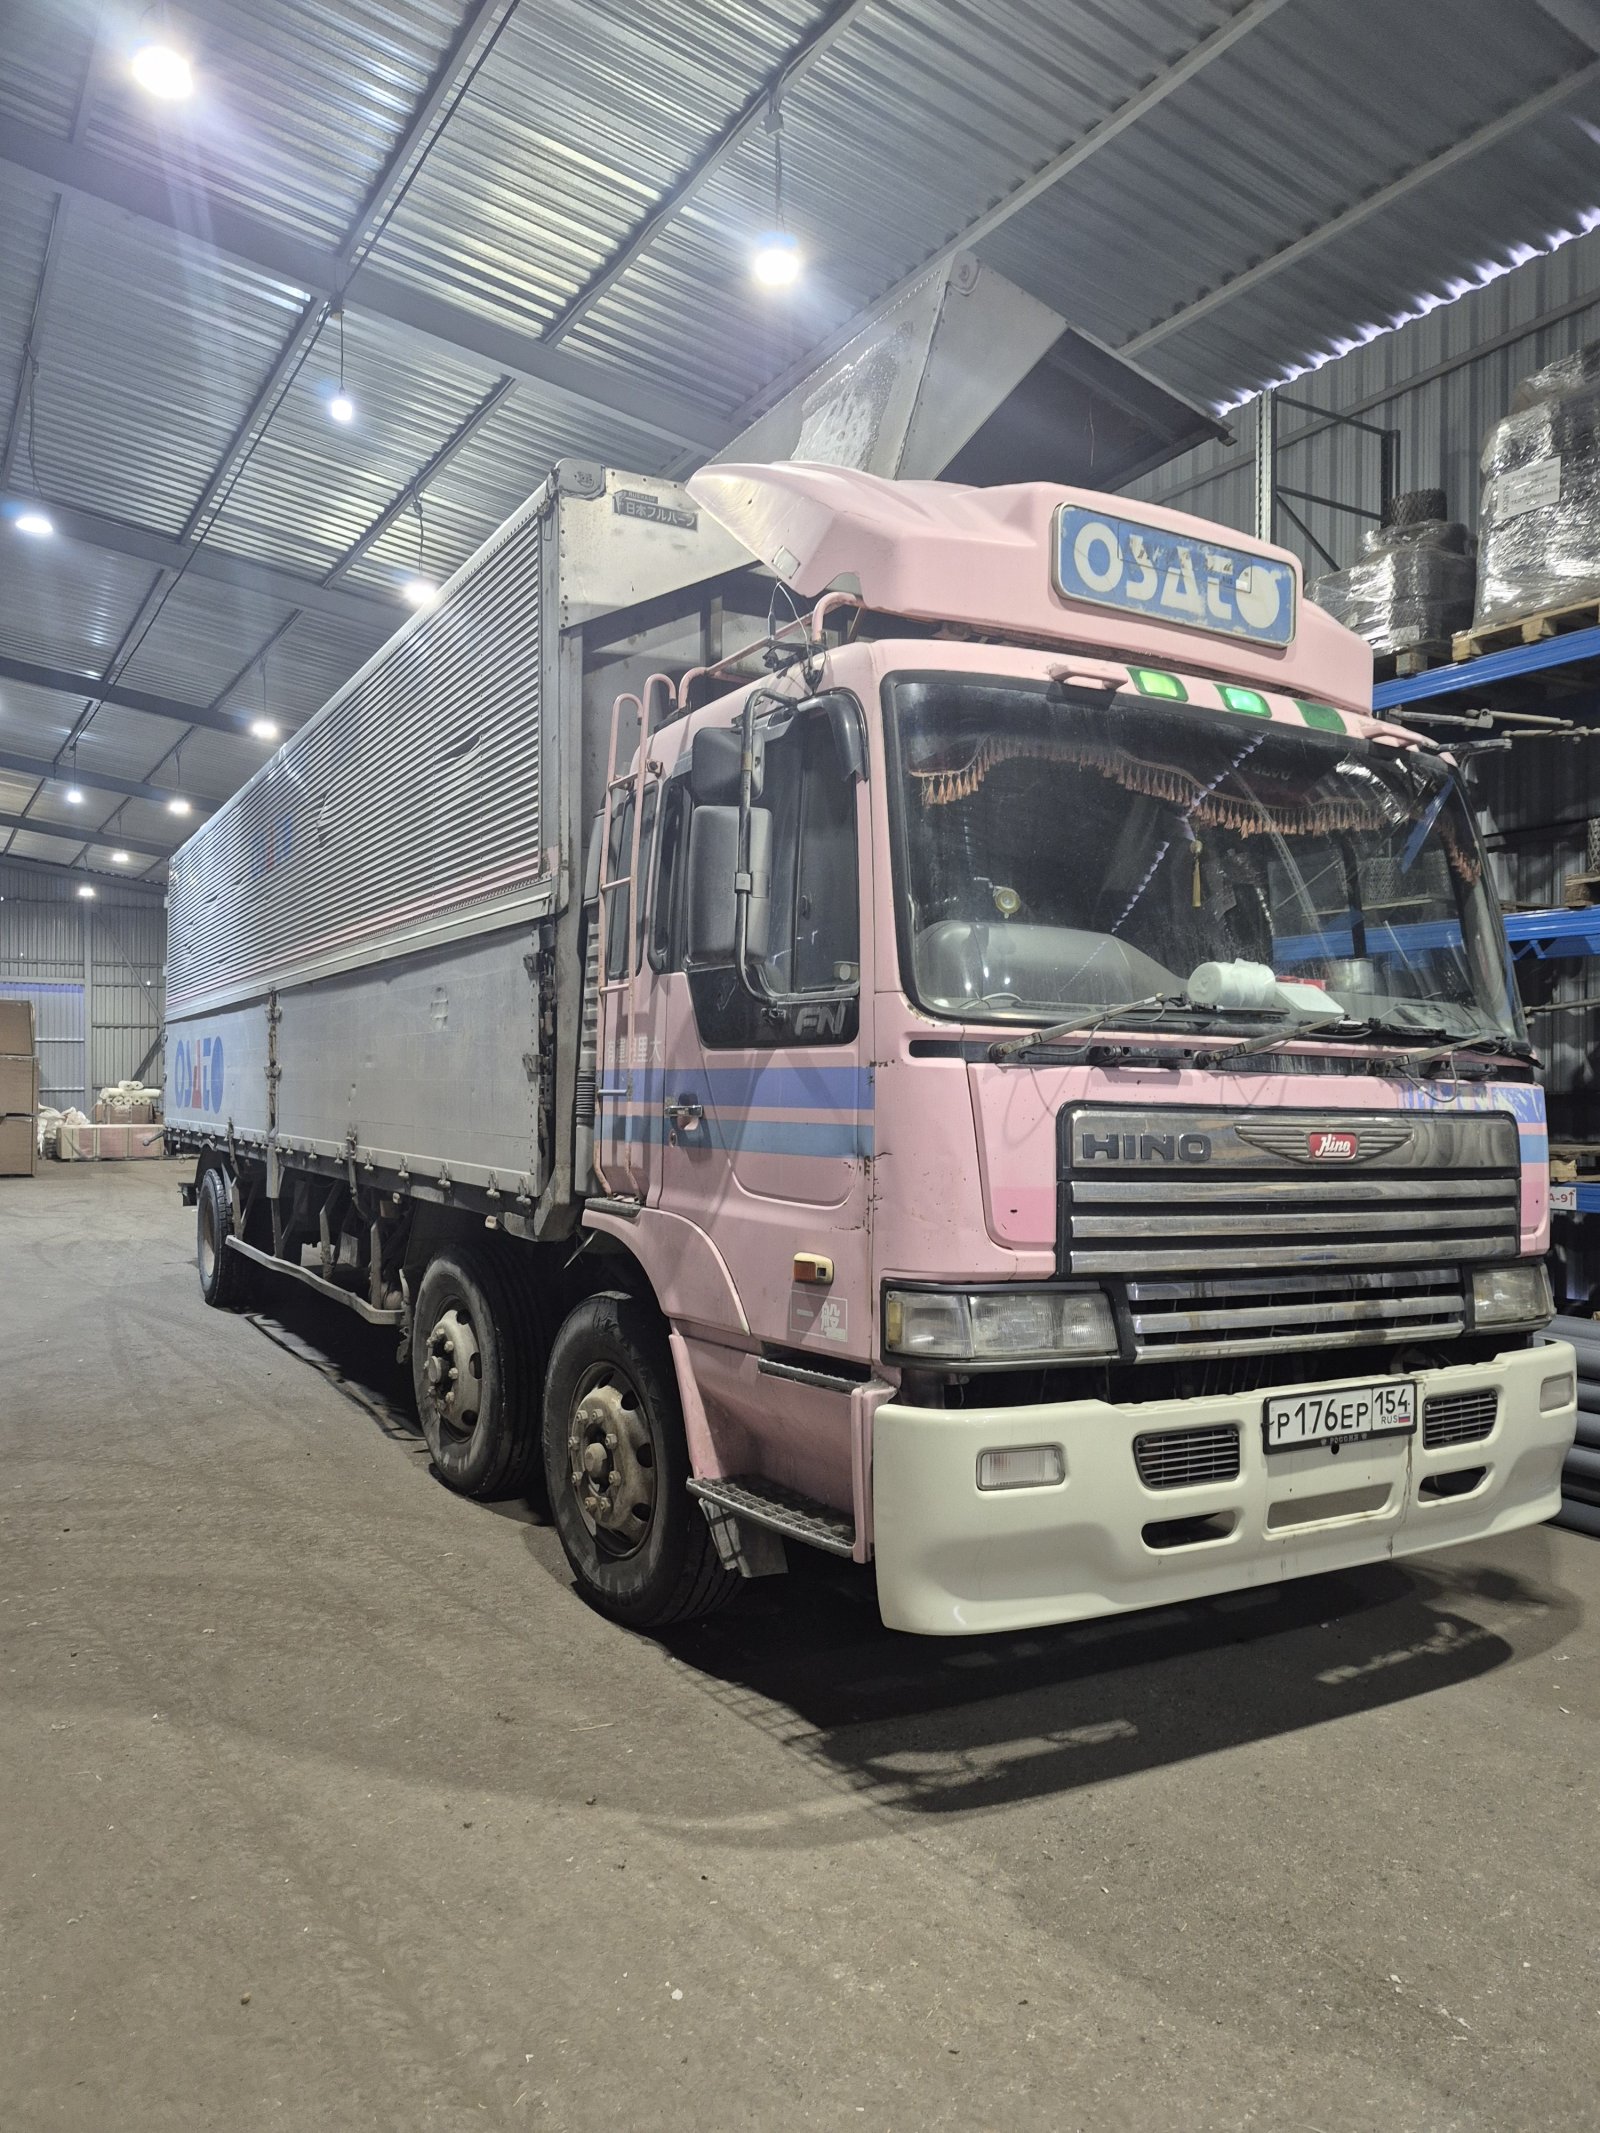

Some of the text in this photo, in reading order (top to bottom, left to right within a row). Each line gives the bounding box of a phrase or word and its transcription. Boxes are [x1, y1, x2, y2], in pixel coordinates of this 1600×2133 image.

[626, 502, 696, 527] 日本フルハーフ
[794, 1000, 846, 1036] FN
[1082, 1132, 1212, 1162] HINO
[1314, 1133, 1352, 1157] Hino
[1375, 1389, 1408, 1416] 154
[1381, 1415, 1399, 1425] RUS
